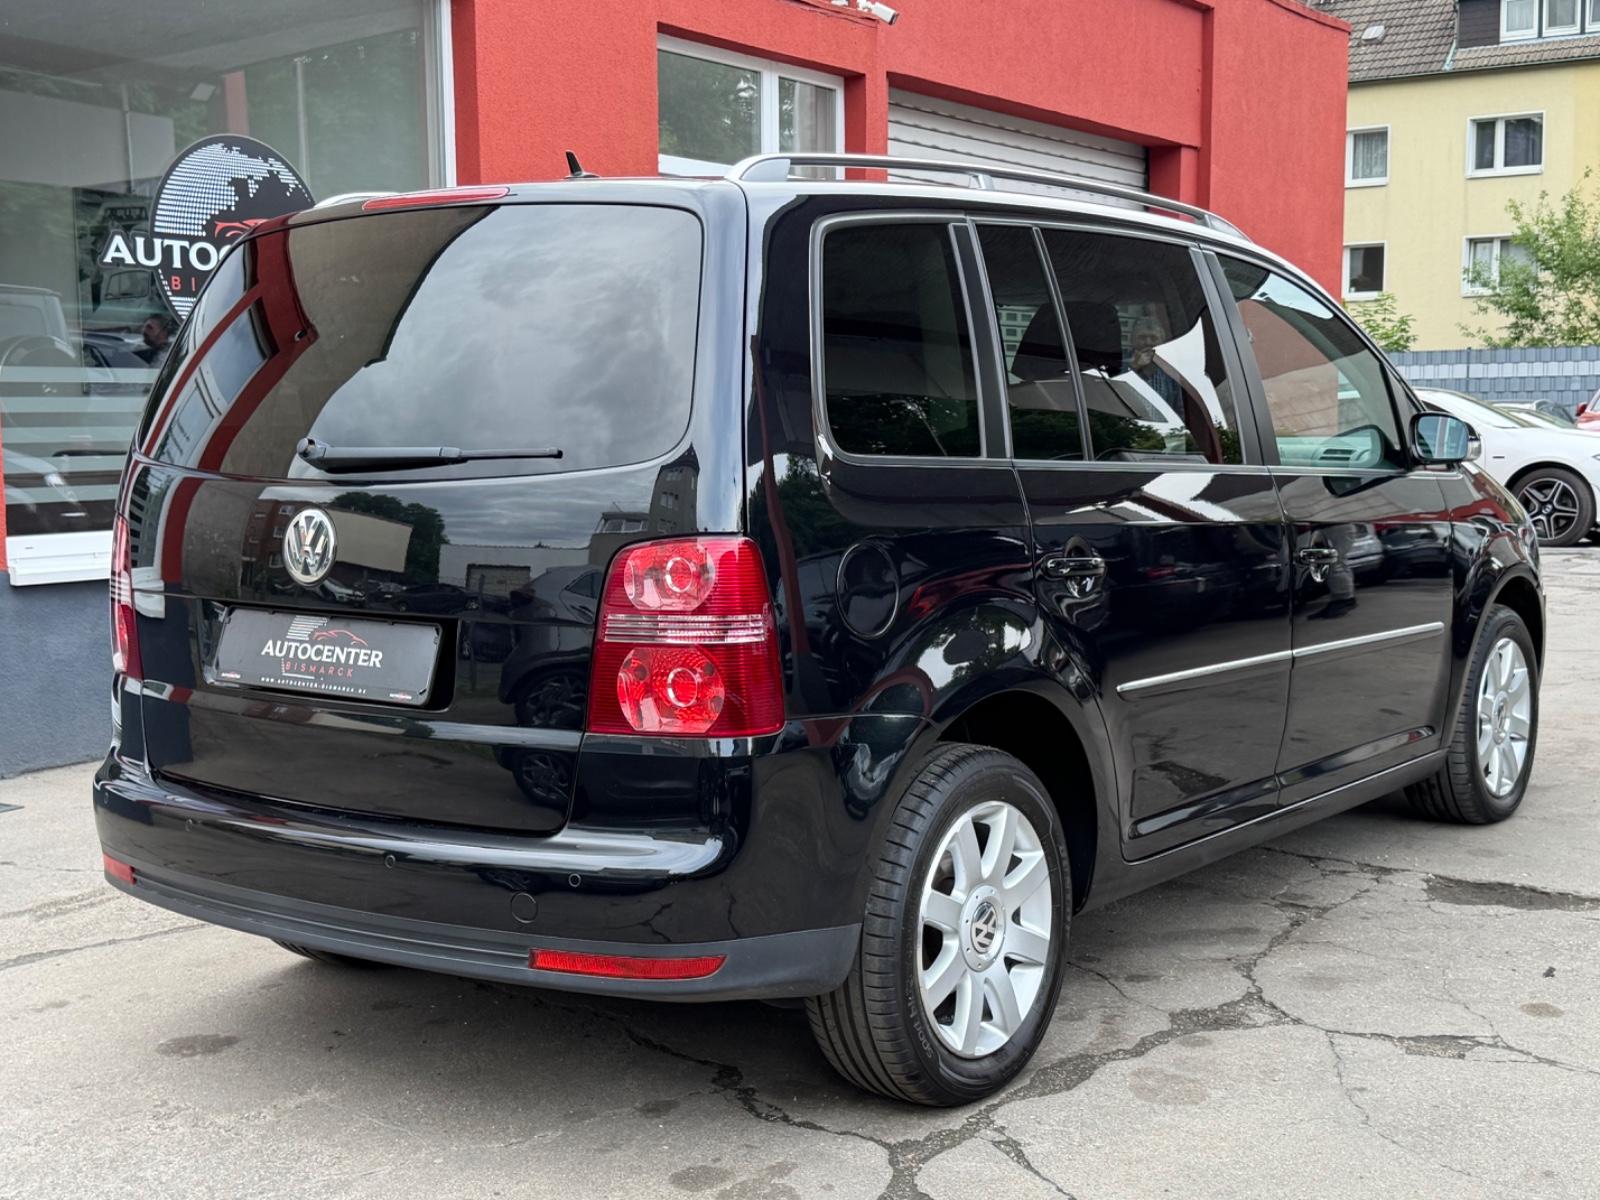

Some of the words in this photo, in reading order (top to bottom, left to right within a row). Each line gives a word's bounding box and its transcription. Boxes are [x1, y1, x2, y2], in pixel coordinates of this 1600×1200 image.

[103, 235, 231, 271] AUTO
[171, 275, 196, 291] BI
[284, 509, 336, 585] VW
[261, 640, 383, 668] AUTOCENTER
[285, 661, 353, 678] BISMARCK
